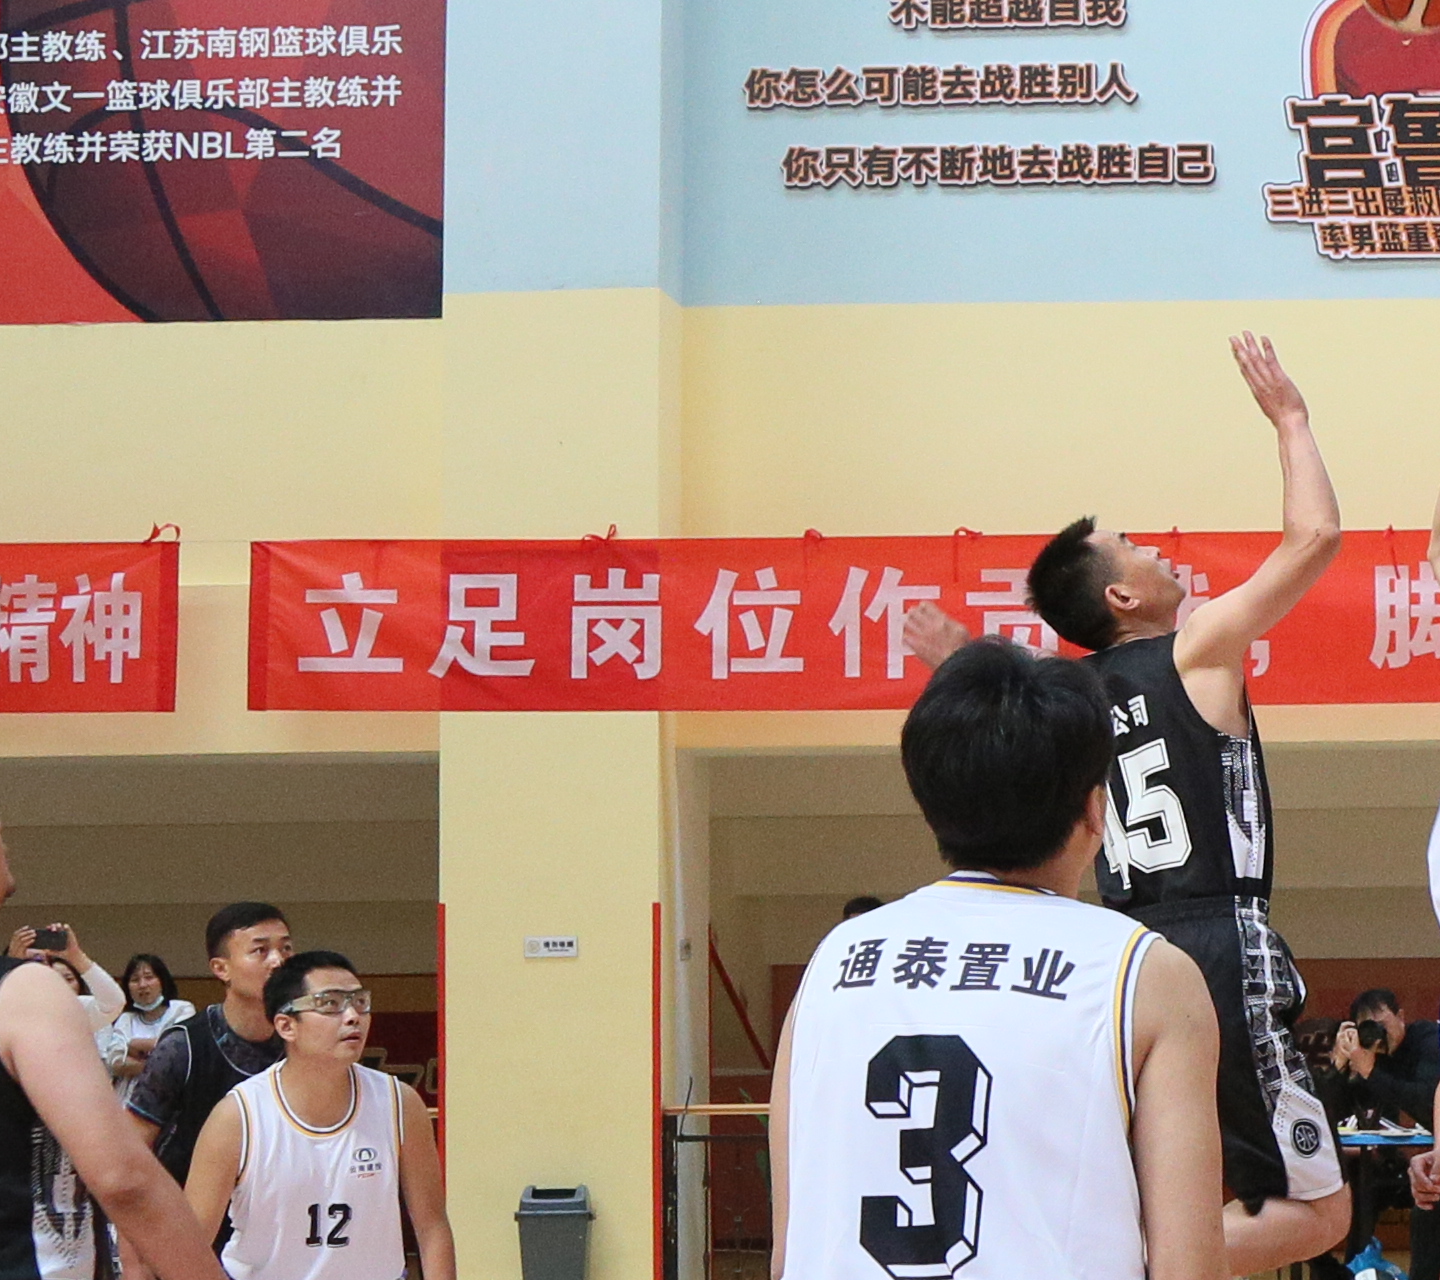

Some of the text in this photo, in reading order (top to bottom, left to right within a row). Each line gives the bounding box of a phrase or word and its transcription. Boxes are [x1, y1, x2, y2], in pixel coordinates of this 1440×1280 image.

[745, 64, 1137, 107] 你怎么可能去战胜别人
[782, 144, 1215, 187] 你只有不断地去战胜自己
[833, 936, 1076, 1001] 通泰置业
[860, 1034, 993, 1280] 3
[306, 1203, 352, 1248] 12
